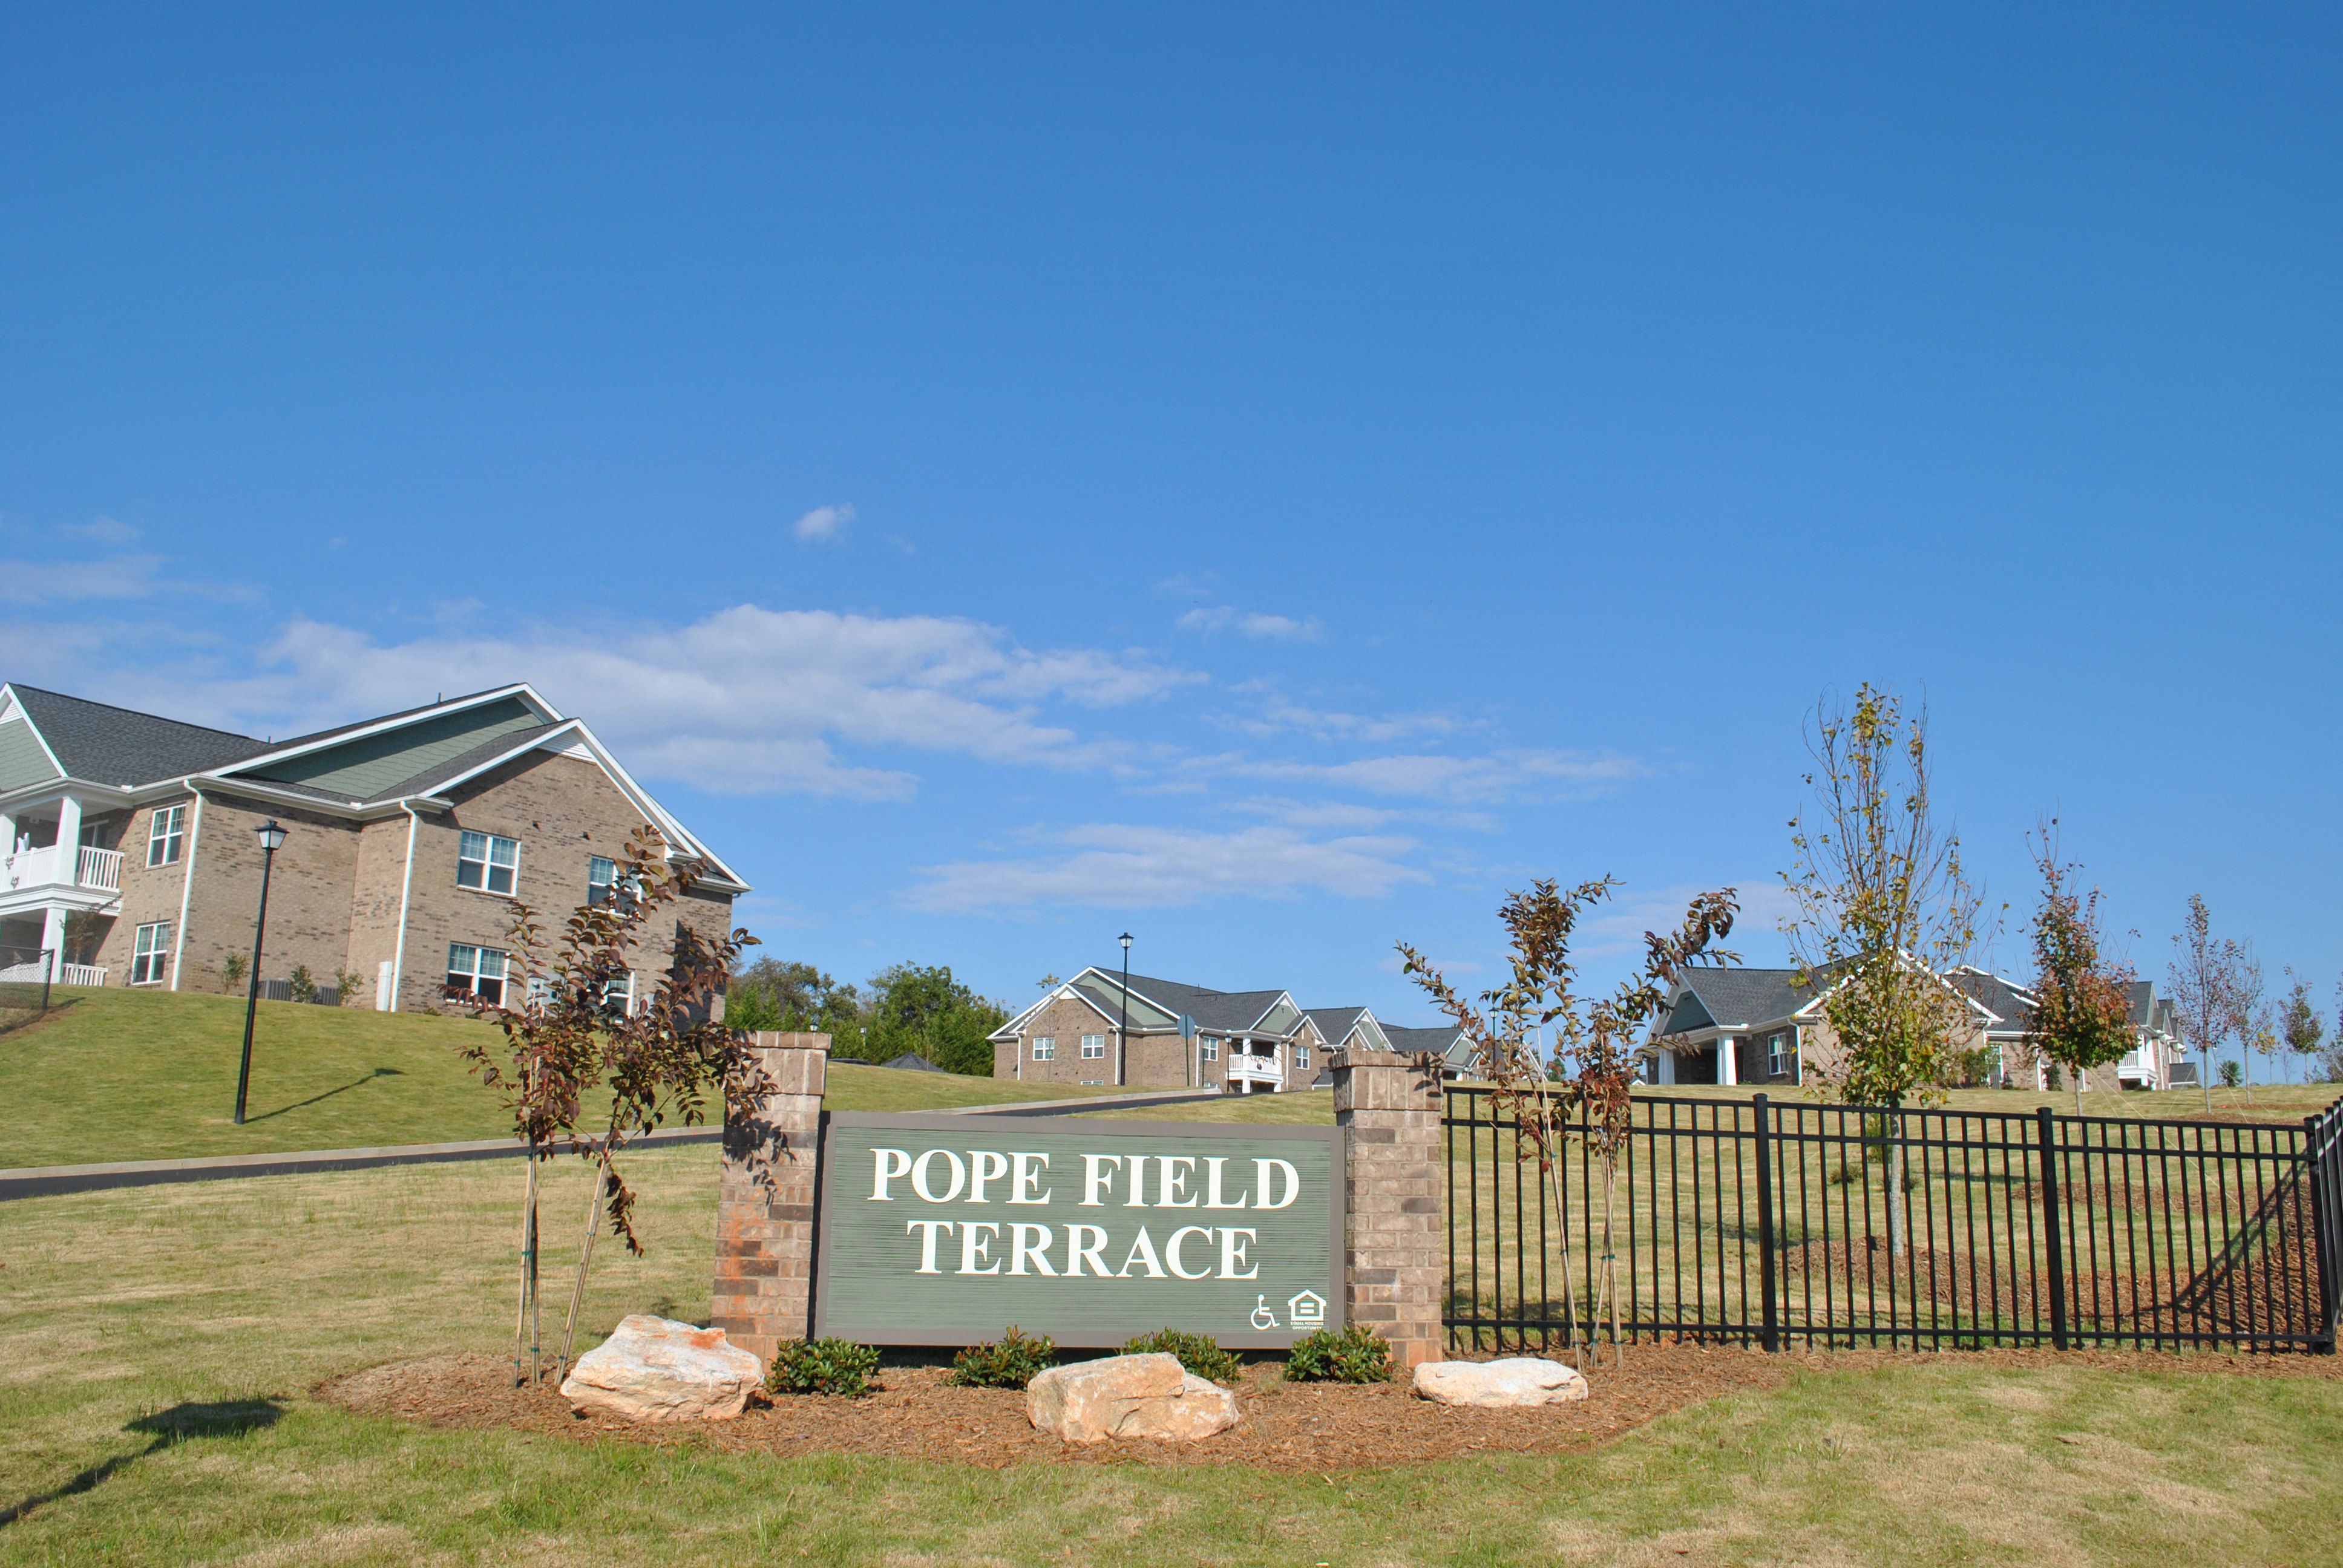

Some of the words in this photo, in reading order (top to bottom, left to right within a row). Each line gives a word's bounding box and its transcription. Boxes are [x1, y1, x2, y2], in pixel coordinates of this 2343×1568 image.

[868, 1148, 1052, 1204] POPE
[1078, 1154, 1300, 1209] FIELD
[907, 1220, 1259, 1279] TERRACE
